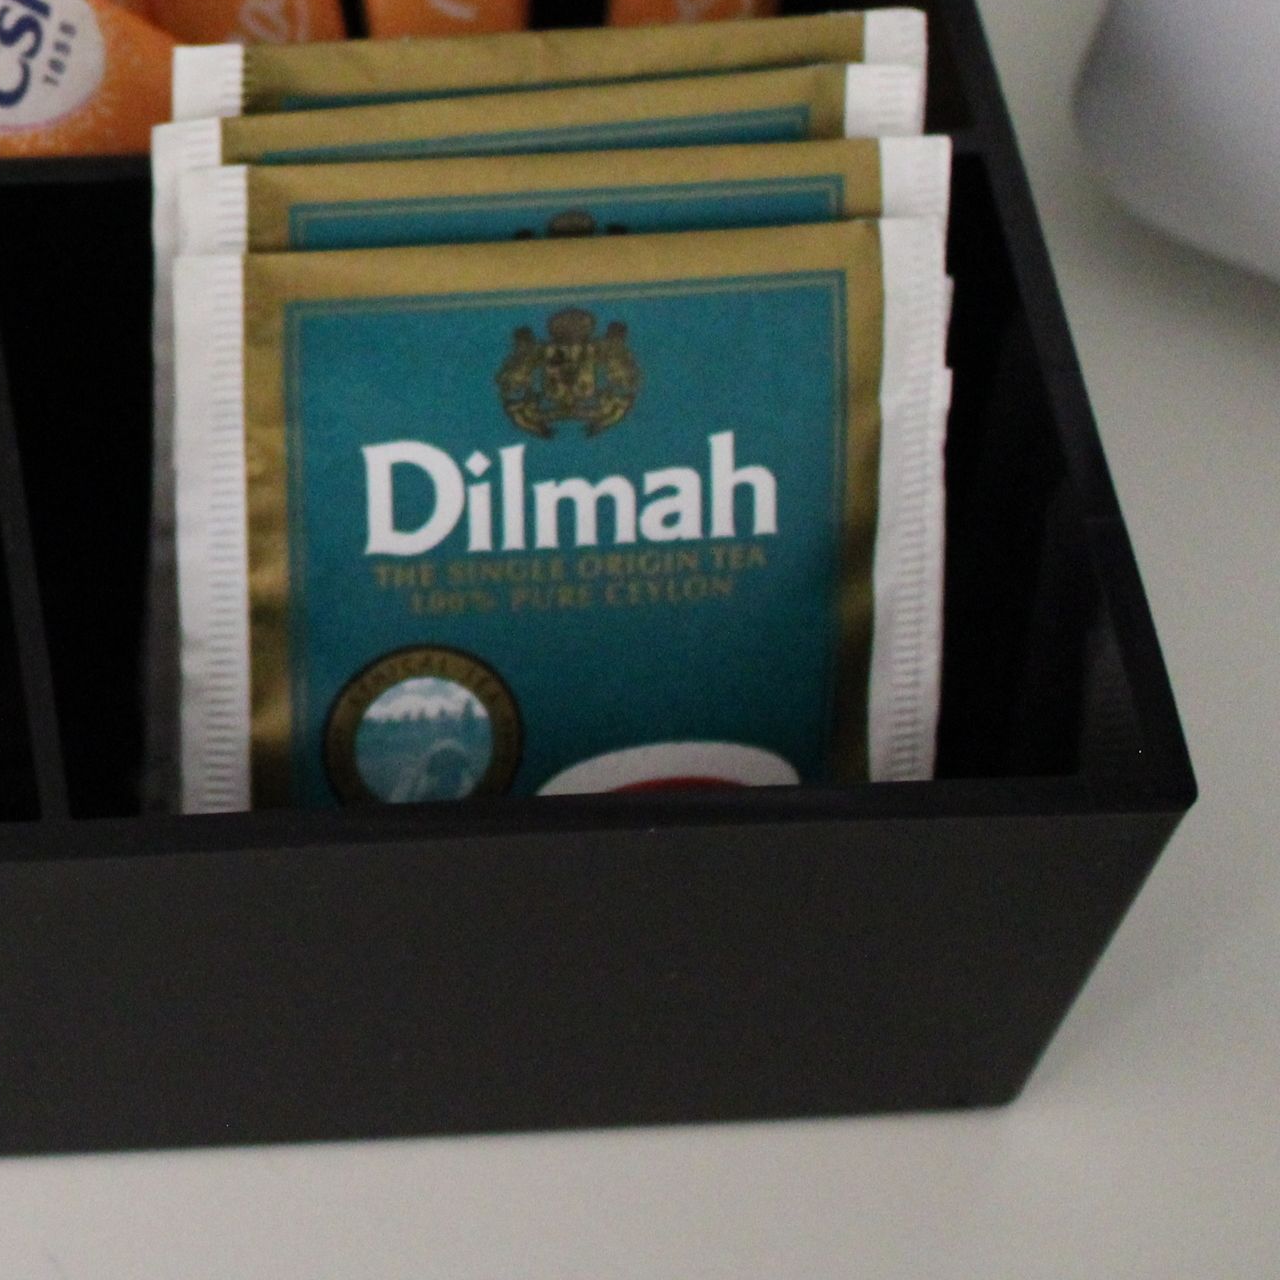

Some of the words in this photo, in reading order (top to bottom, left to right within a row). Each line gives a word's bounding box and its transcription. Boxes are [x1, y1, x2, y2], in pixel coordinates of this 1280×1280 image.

[361, 430, 778, 556] Dilmah
[374, 562, 436, 587] THE
[448, 556, 564, 583] SINGLE
[578, 549, 698, 578] ORIGIN
[712, 545, 767, 569] TEA
[509, 584, 590, 611] PURE
[604, 576, 734, 606] CEYLON
